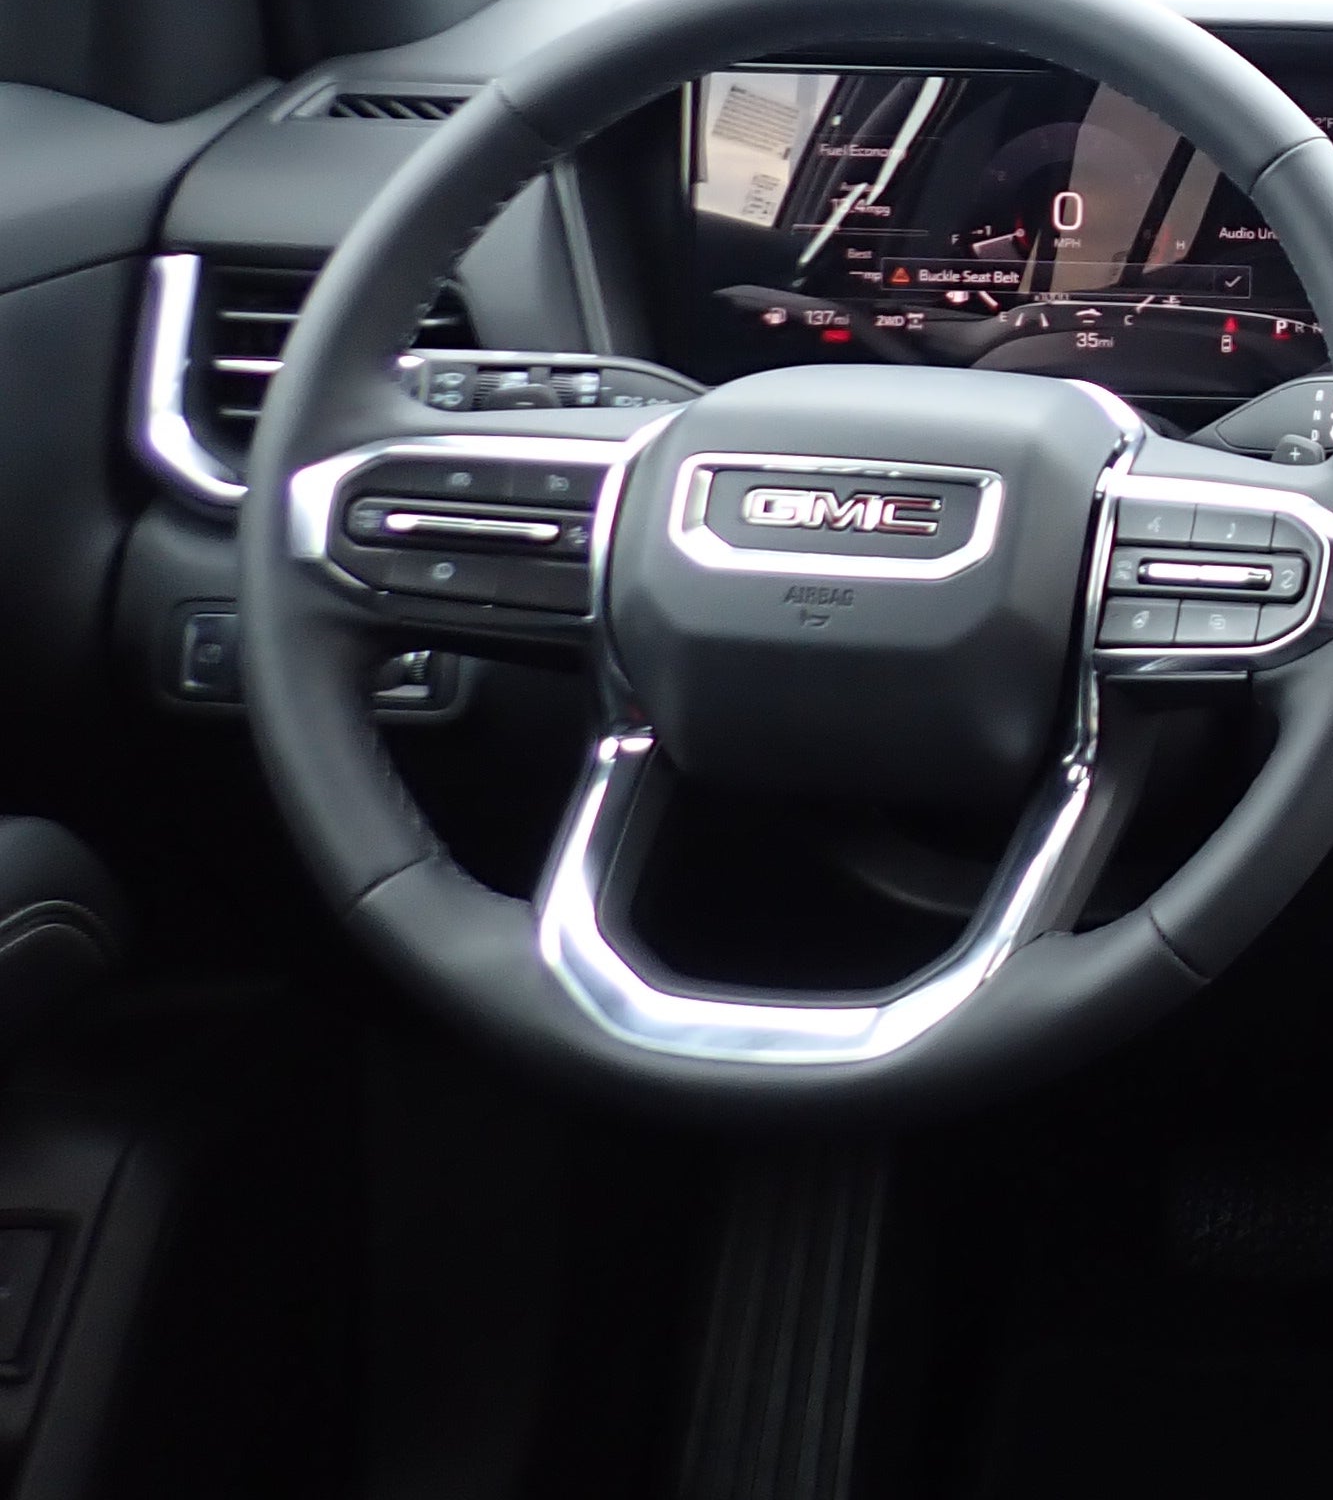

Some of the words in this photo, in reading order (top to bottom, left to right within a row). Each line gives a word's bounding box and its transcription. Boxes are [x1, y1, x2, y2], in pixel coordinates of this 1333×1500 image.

[820, 143, 848, 157] Fuel
[1053, 191, 1082, 231] 0
[1218, 227, 1255, 240] Audio
[1054, 238, 1081, 248] MPH
[918, 269, 960, 283] Buckle
[961, 271, 992, 283] Seat
[993, 271, 1020, 284] Belt
[1275, 320, 1289, 335] P
[743, 487, 942, 537] GMC
[783, 585, 855, 606] AIRBAG
